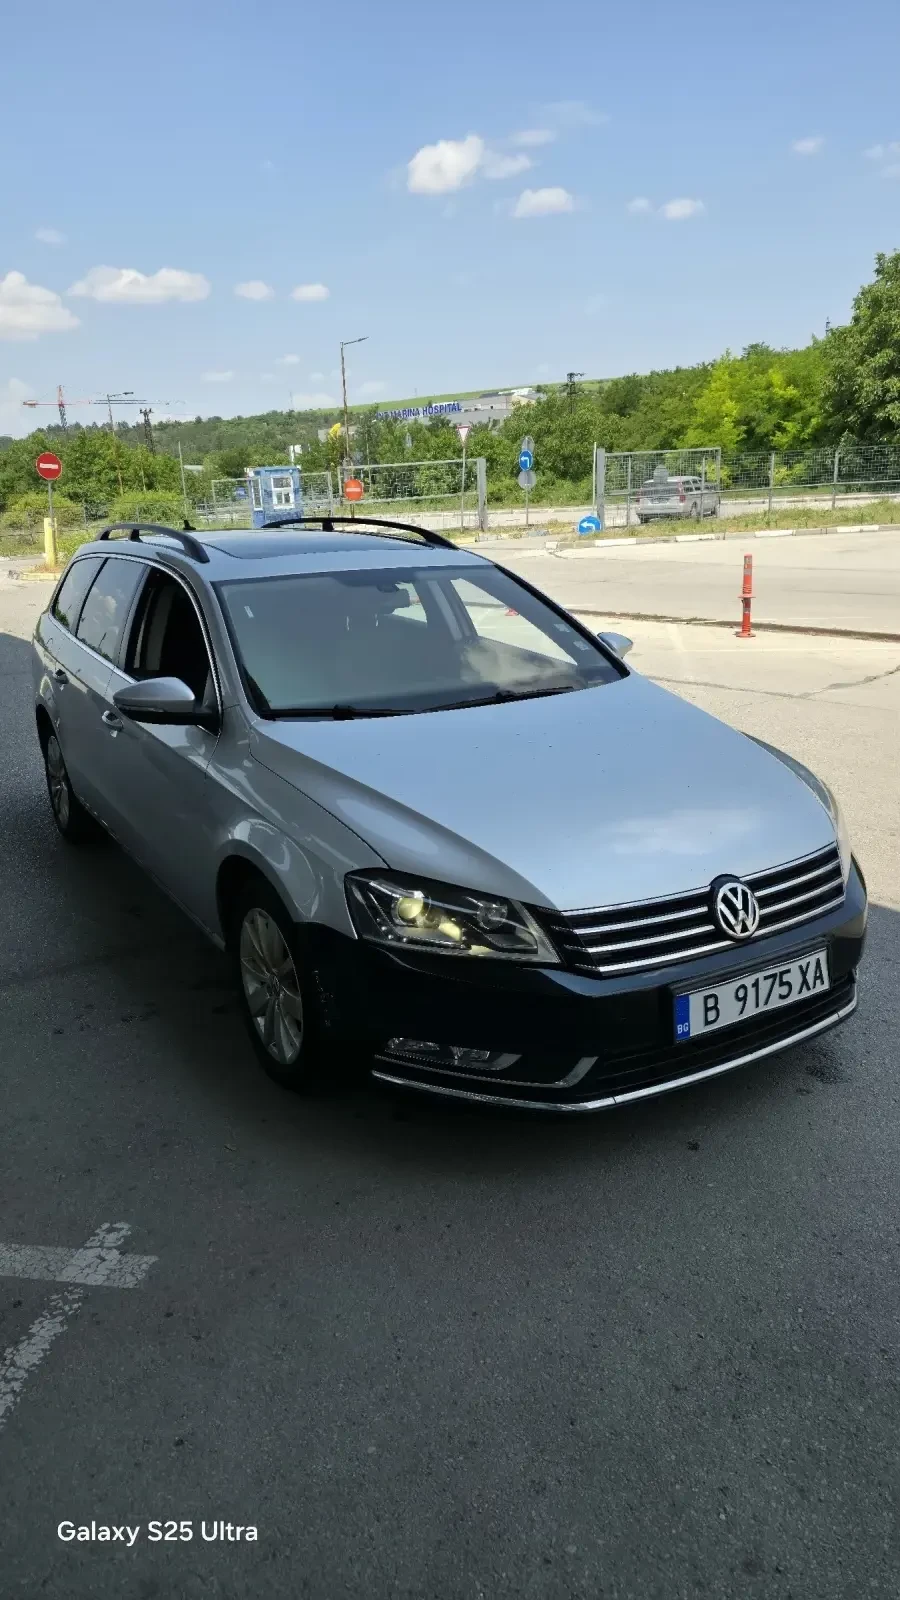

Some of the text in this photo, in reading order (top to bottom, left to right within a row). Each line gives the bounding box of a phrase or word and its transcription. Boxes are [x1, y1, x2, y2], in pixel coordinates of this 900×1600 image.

[390, 408, 420, 419] MARINA
[422, 402, 462, 416] HOSPITAL
[704, 957, 824, 1026] B 9175 XA
[677, 1022, 689, 1034] BG
